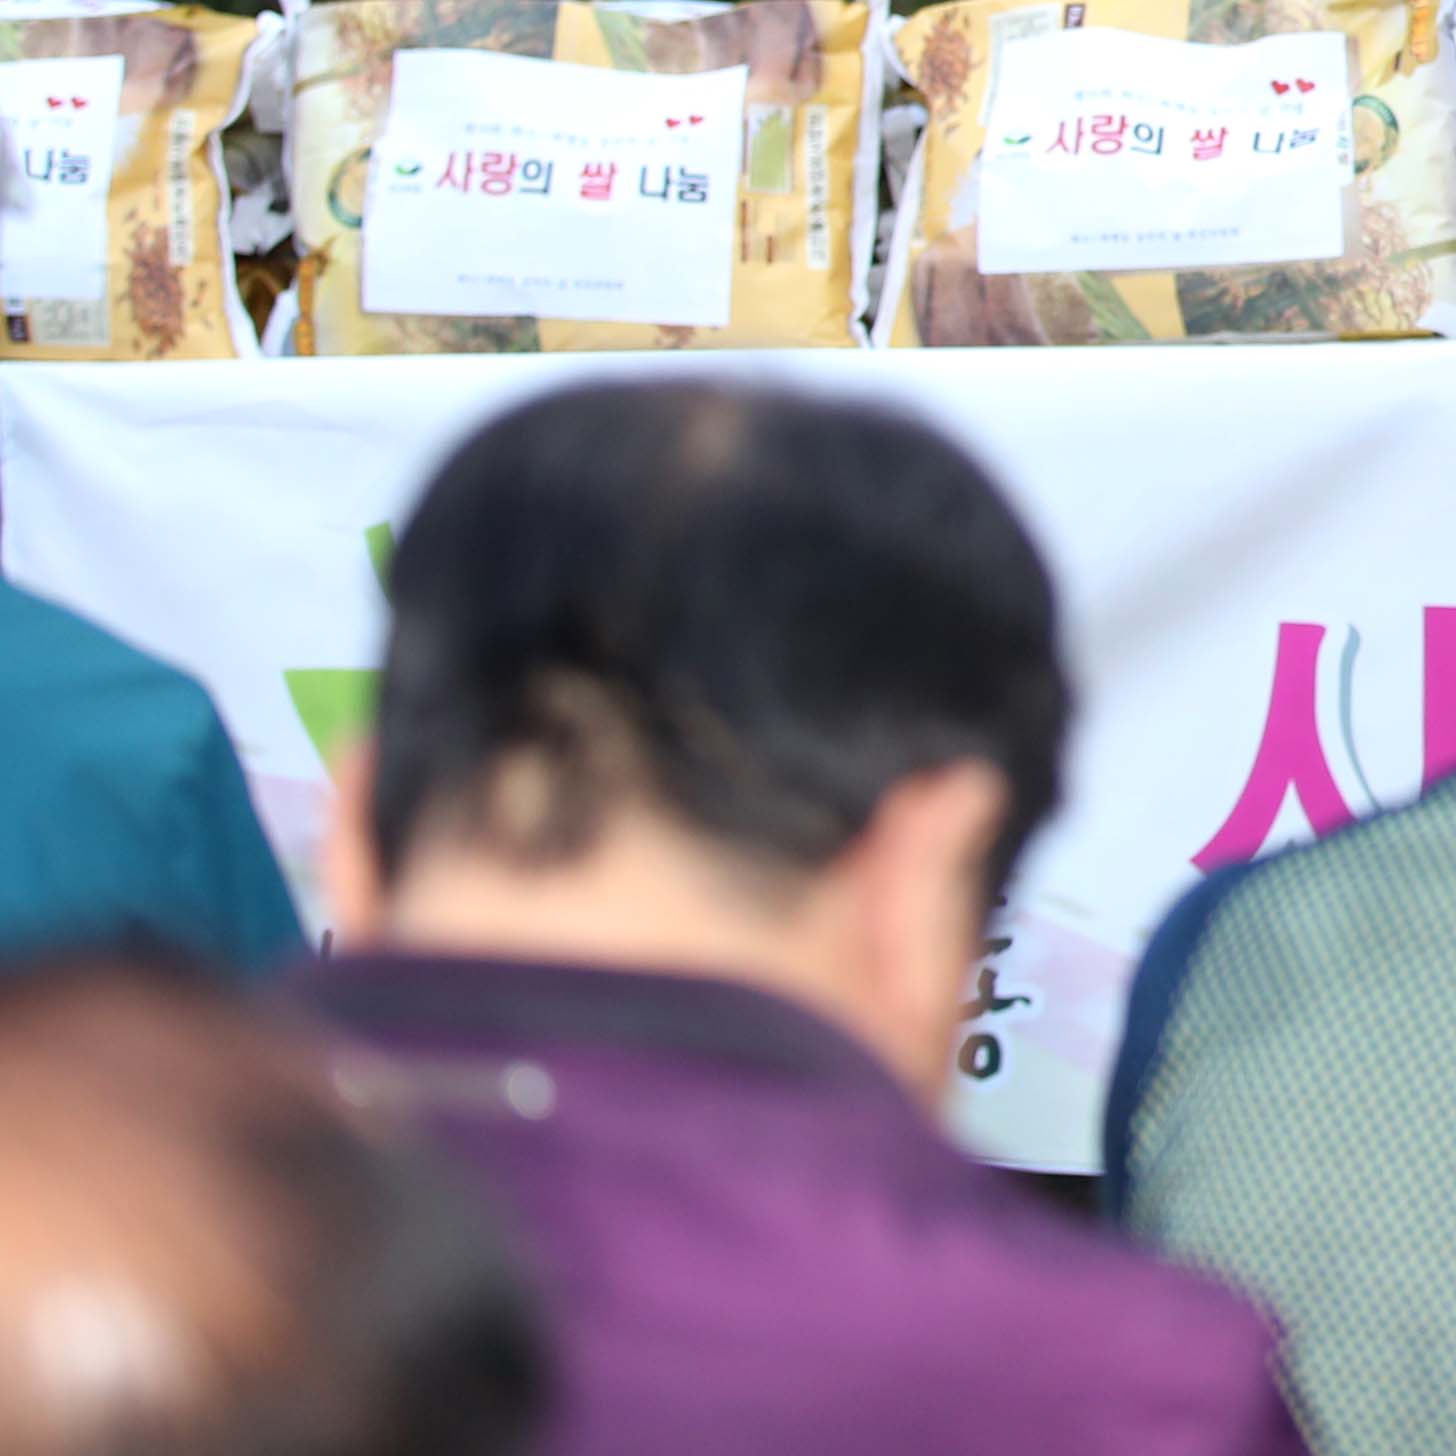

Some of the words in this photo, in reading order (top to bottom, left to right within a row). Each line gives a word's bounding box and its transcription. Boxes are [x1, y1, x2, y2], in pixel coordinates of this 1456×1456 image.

[1044, 114, 1164, 156] 사랑의
[1190, 126, 1229, 161] 쌀
[24, 148, 91, 184] 나눔
[434, 151, 554, 197] 사랑의
[580, 161, 619, 202] 쌀
[638, 164, 708, 204] 나눔
